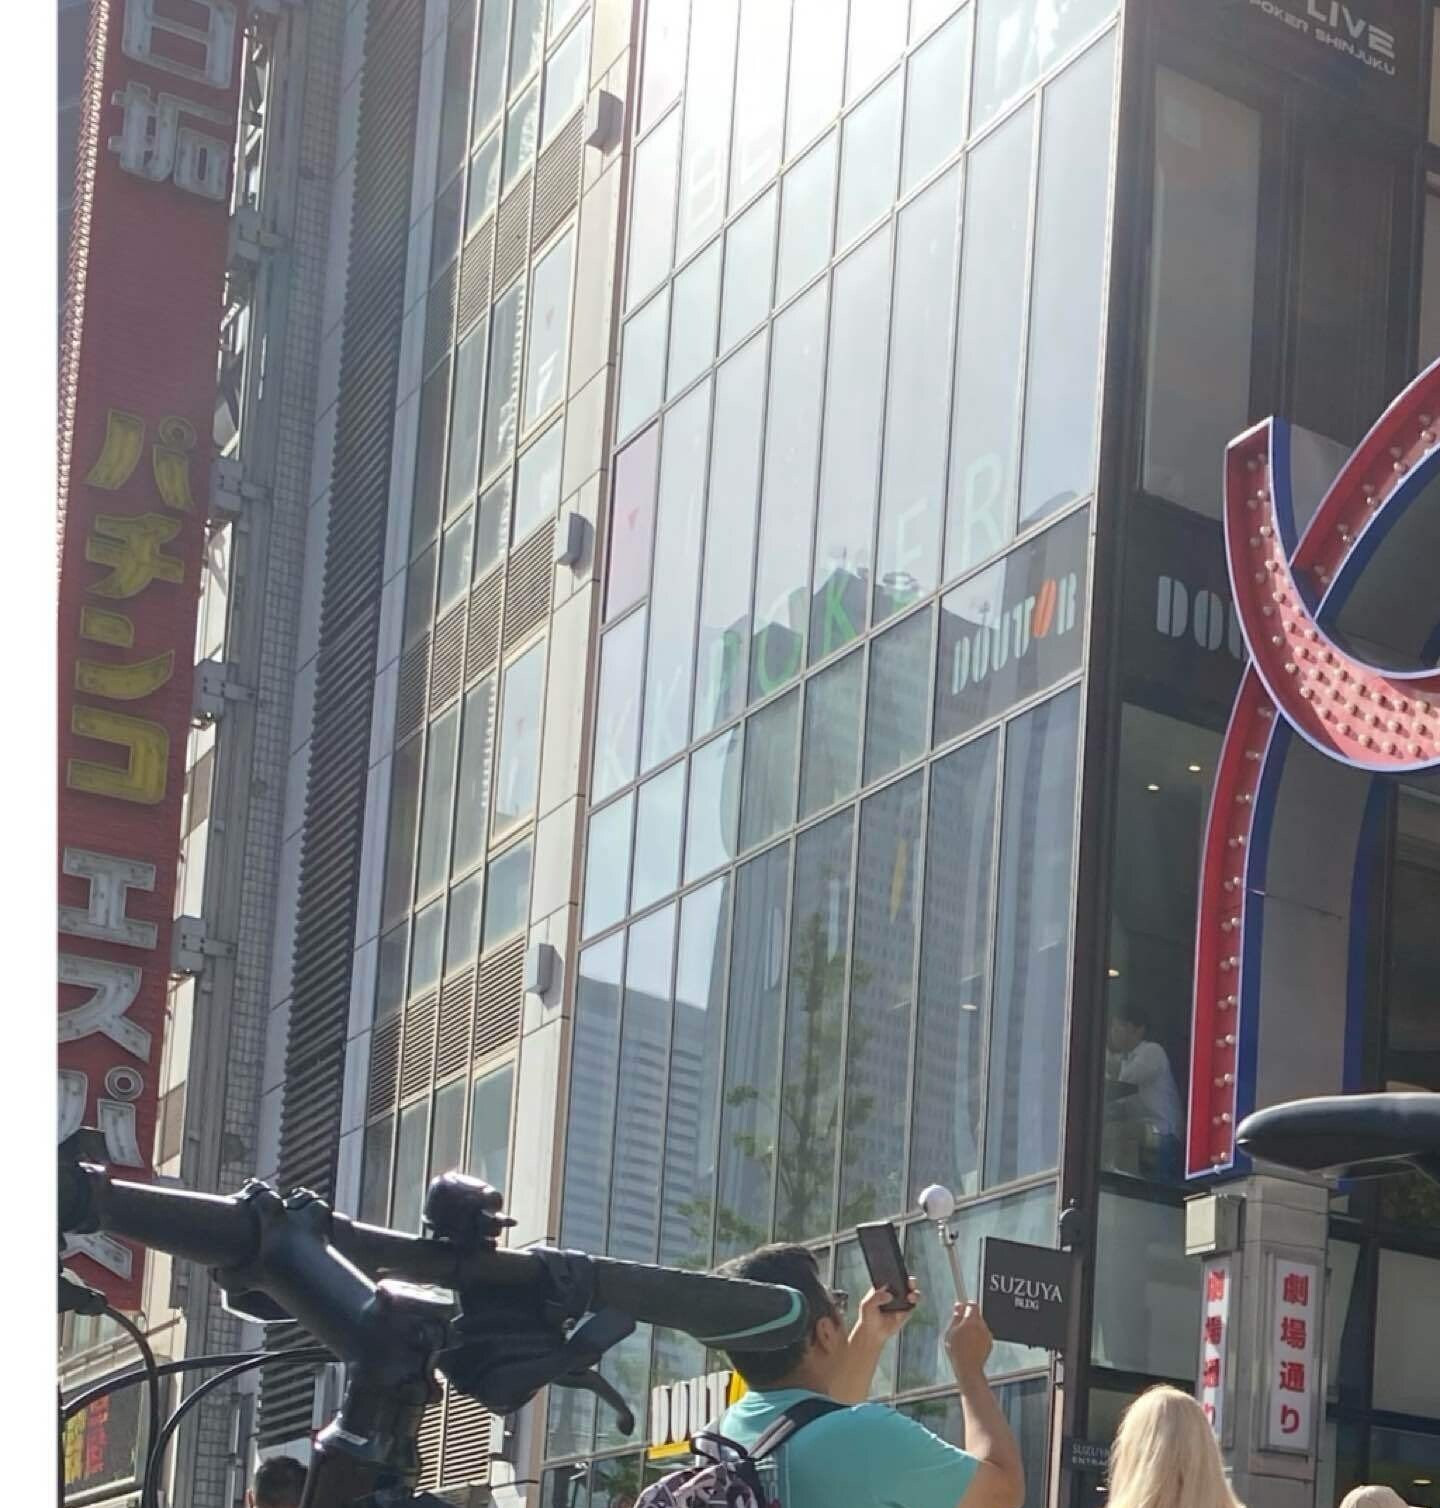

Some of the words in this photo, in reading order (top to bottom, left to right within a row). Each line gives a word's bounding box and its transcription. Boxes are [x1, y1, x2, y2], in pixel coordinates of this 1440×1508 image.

[65, 408, 198, 806] パチンコ
[952, 572, 1078, 696] DOUTOR
[989, 1273, 1063, 1303] SUZUYA
[1279, 1272, 1310, 1435] 劇場通り
